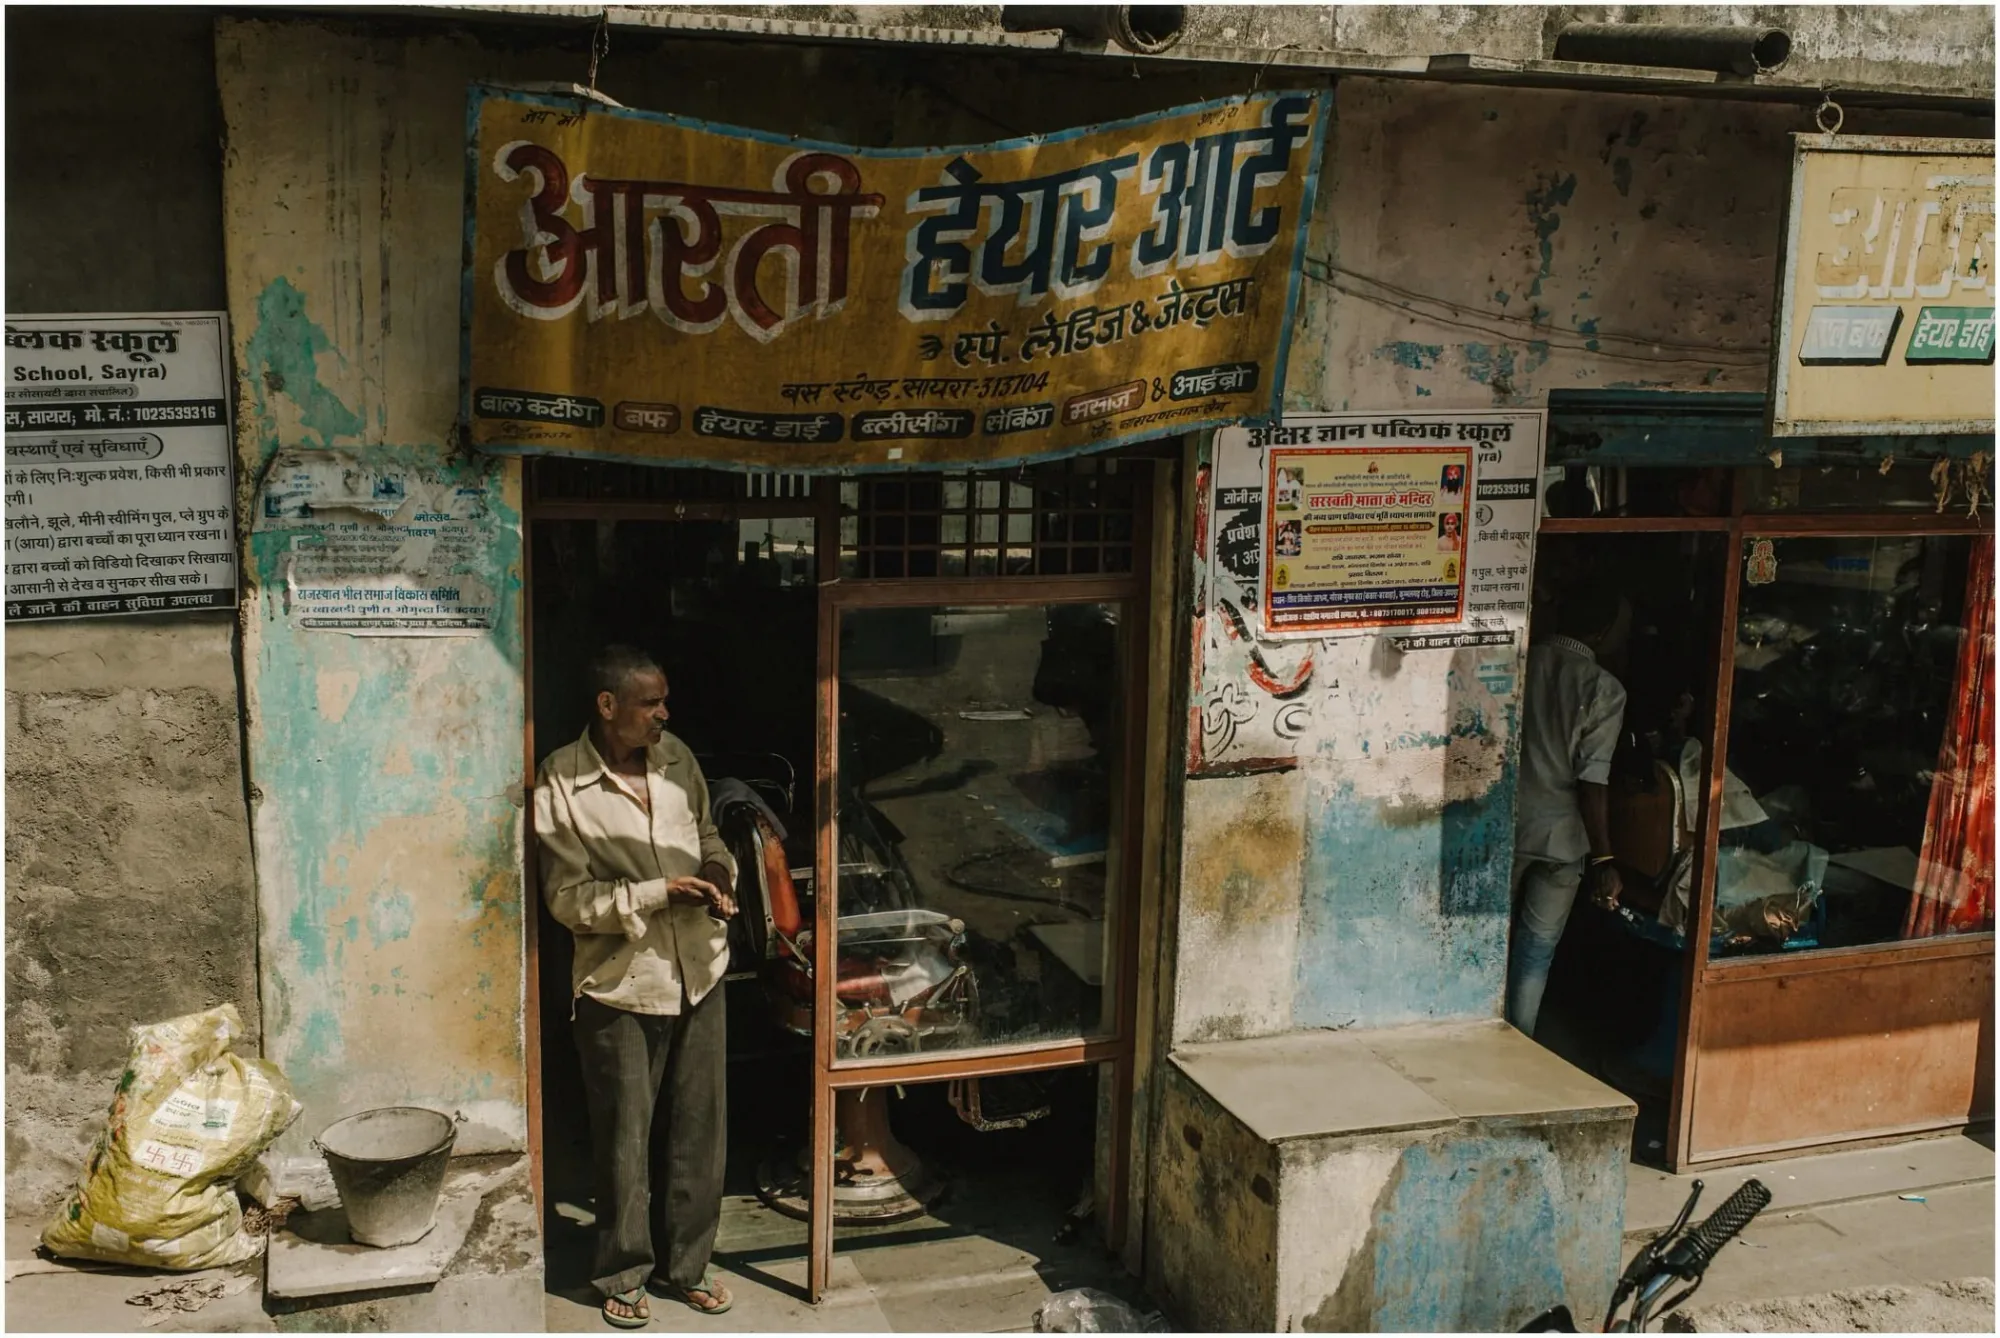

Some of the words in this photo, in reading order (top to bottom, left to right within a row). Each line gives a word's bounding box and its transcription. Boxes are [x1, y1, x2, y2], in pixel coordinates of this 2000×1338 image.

[493, 140, 886, 344] आरती
[898, 156, 1140, 323] हेयर
[1130, 96, 1311, 278] आर्ट
[90, 329, 181, 363] स्कूल
[14, 365, 93, 381] School,
[101, 363, 167, 382] Sayra)
[781, 383, 830, 405] बस
[1151, 377, 1167, 402] &
[84, 405, 105, 422] मो.
[134, 405, 216, 421] 7023539316
[480, 395, 524, 413] बाल
[625, 409, 674, 428] बफ
[1317, 422, 1367, 441] ज्ञान
[1372, 419, 1453, 439] पब्लिक
[1457, 422, 1511, 450] स्कूल
[61, 440, 84, 458] एवं
[16, 472, 28, 485] के
[31, 469, 56, 486] लिए
[108, 466, 142, 482] प्रवेश,
[145, 465, 177, 480] किसी
[178, 465, 192, 478] भी
[194, 466, 226, 478] प्रकार
[1223, 488, 1248, 505] सोनी
[1309, 492, 1354, 507] सरस्वती
[1355, 495, 1382, 507] माता
[1385, 491, 1397, 505] के
[1399, 491, 1432, 505] मन्दिर
[1478, 483, 1531, 496] 7023539316
[78, 511, 105, 527] मीनी
[179, 507, 194, 521] प्ले
[217, 505, 230, 518] के
[15, 535, 55, 552] (आया)
[57, 536, 83, 549] द्वारा
[86, 531, 115, 546] बच्चों
[117, 533, 133, 545] का
[135, 532, 156, 548] पूरा
[157, 530, 185, 542] ध्यान
[1227, 523, 1255, 544] प्रवेश
[1478, 530, 1499, 542] किसी
[1500, 529, 1509, 541] भी
[1510, 531, 1531, 540] प्रकार
[12, 561, 38, 576] द्वारा
[41, 556, 71, 572] बच्चों
[73, 556, 90, 571] को
[92, 554, 134, 570] विडियो
[136, 552, 186, 568] दिखाकर
[188, 550, 233, 565] सिखाया
[10, 578, 55, 595] आसानी
[57, 577, 69, 592] से
[72, 577, 94, 592] देख
[96, 579, 105, 590] व
[107, 576, 147, 593] सुनकर
[148, 572, 177, 587] सीख
[298, 588, 340, 600] राजस्थान
[342, 585, 362, 600] भील
[364, 589, 393, 600] समाज
[395, 585, 428, 600] विकास
[430, 585, 460, 601] समिति
[8, 603, 21, 617] ले
[27, 601, 56, 615] जाने
[63, 600, 81, 613] की
[87, 599, 120, 611] वाहन
[124, 595, 165, 612] सुविधा
[170, 593, 214, 606] उपलब्ध
[1497, 599, 1525, 611] सिखाया
[1413, 637, 1426, 648] की
[1429, 637, 1451, 647] वाहन
[1453, 634, 1479, 647] सुविधा
